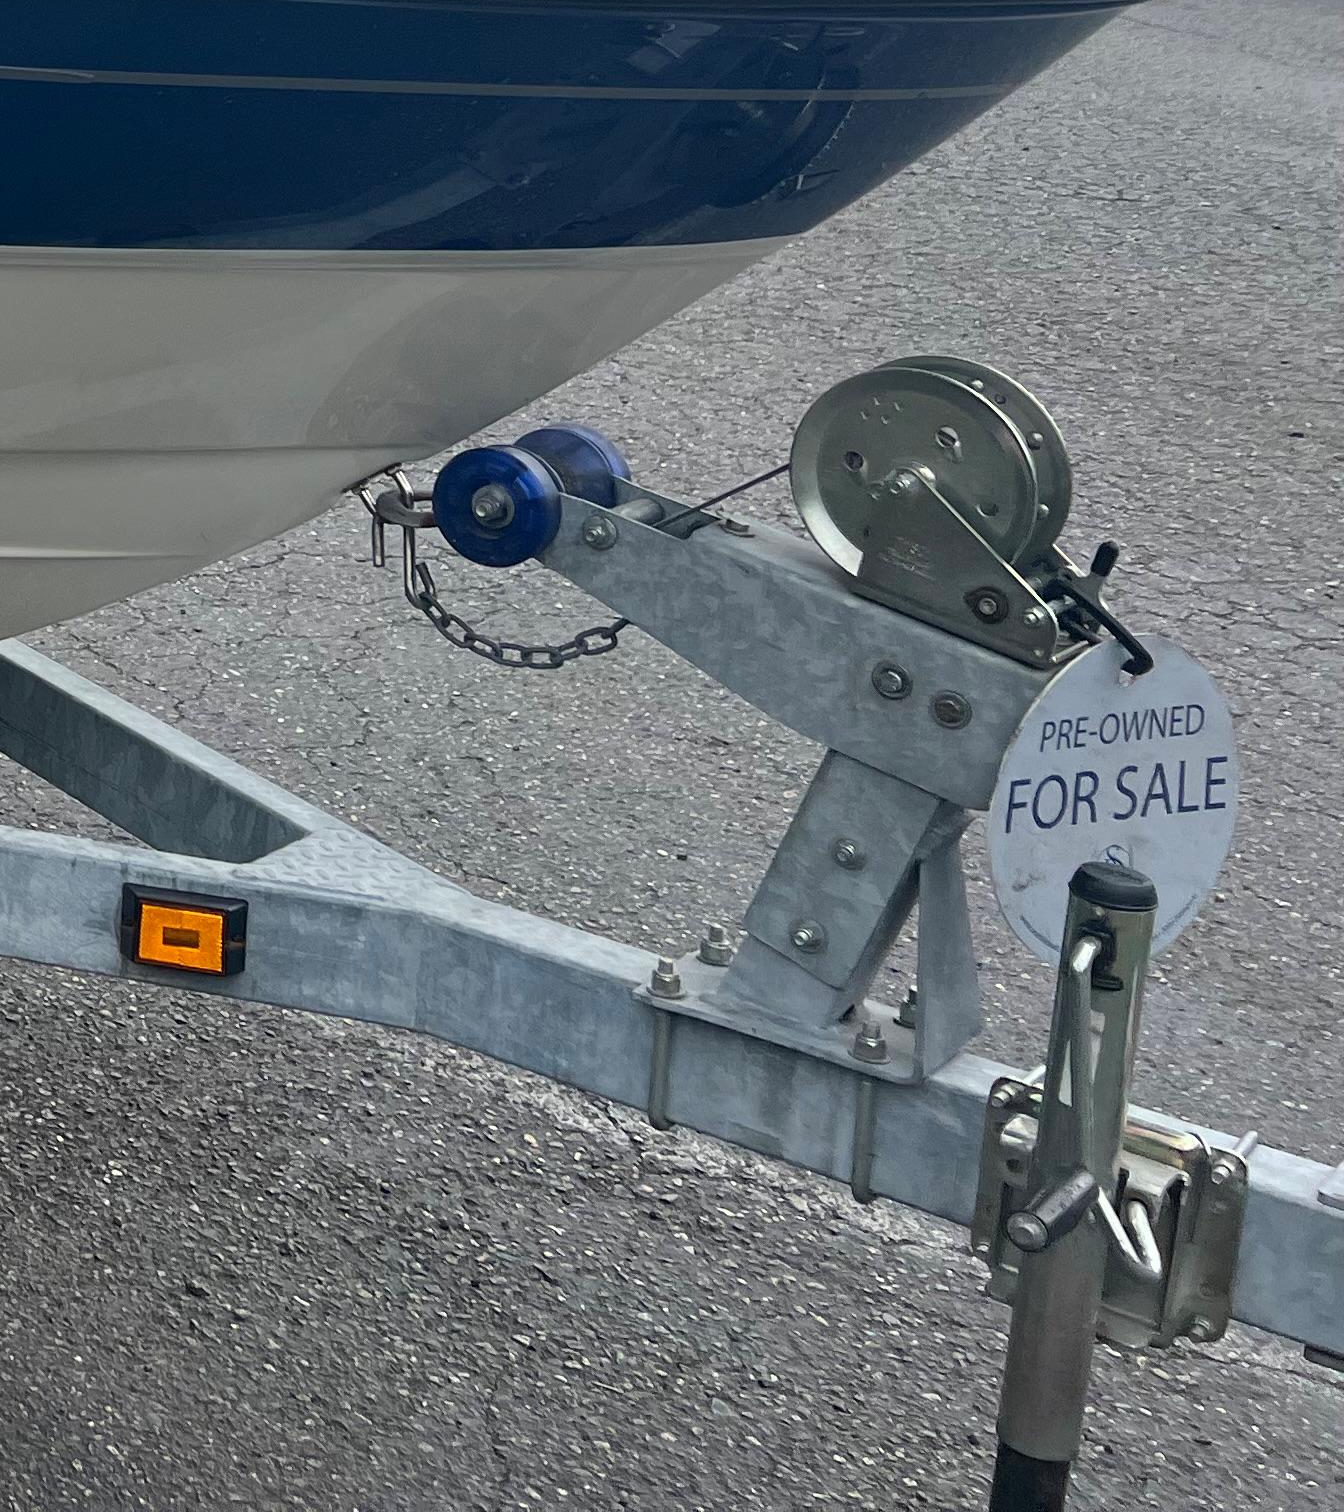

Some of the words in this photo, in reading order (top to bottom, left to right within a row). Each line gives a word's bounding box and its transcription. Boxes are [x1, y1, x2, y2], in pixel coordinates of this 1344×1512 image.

[1039, 703, 1206, 753] PRE-OWNED
[1005, 770, 1100, 834] FOR
[1113, 756, 1228, 821] SALE
